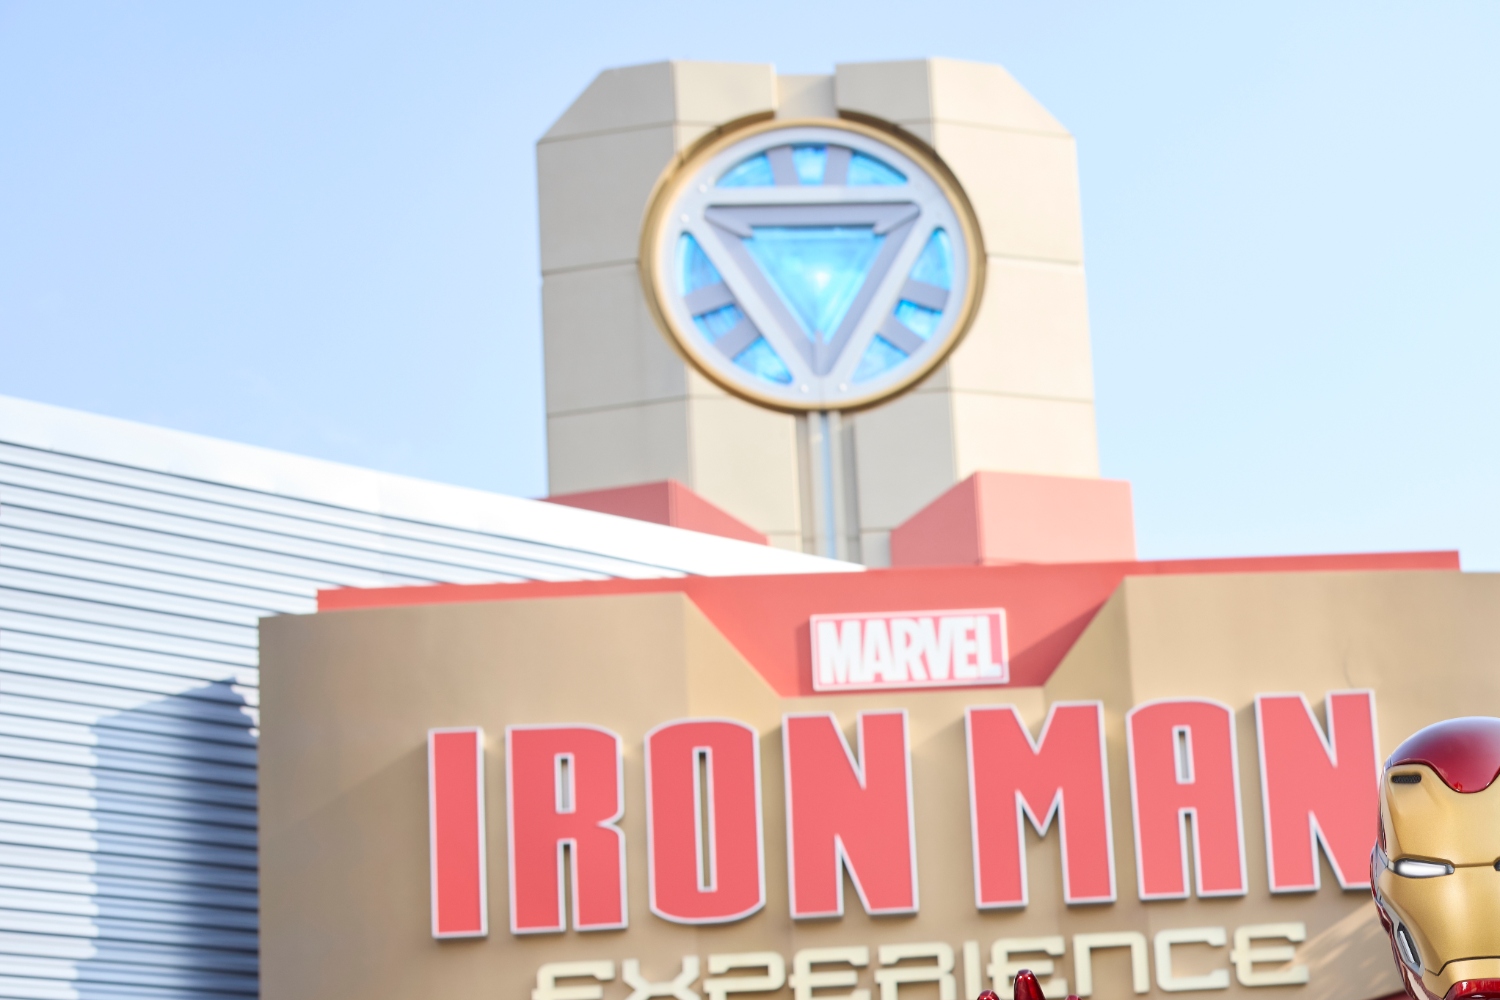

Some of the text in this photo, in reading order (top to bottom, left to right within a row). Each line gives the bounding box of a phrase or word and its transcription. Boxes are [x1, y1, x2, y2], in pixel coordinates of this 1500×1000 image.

[817, 614, 1002, 685] MARVEL
[427, 688, 1381, 939] IRON MAN
